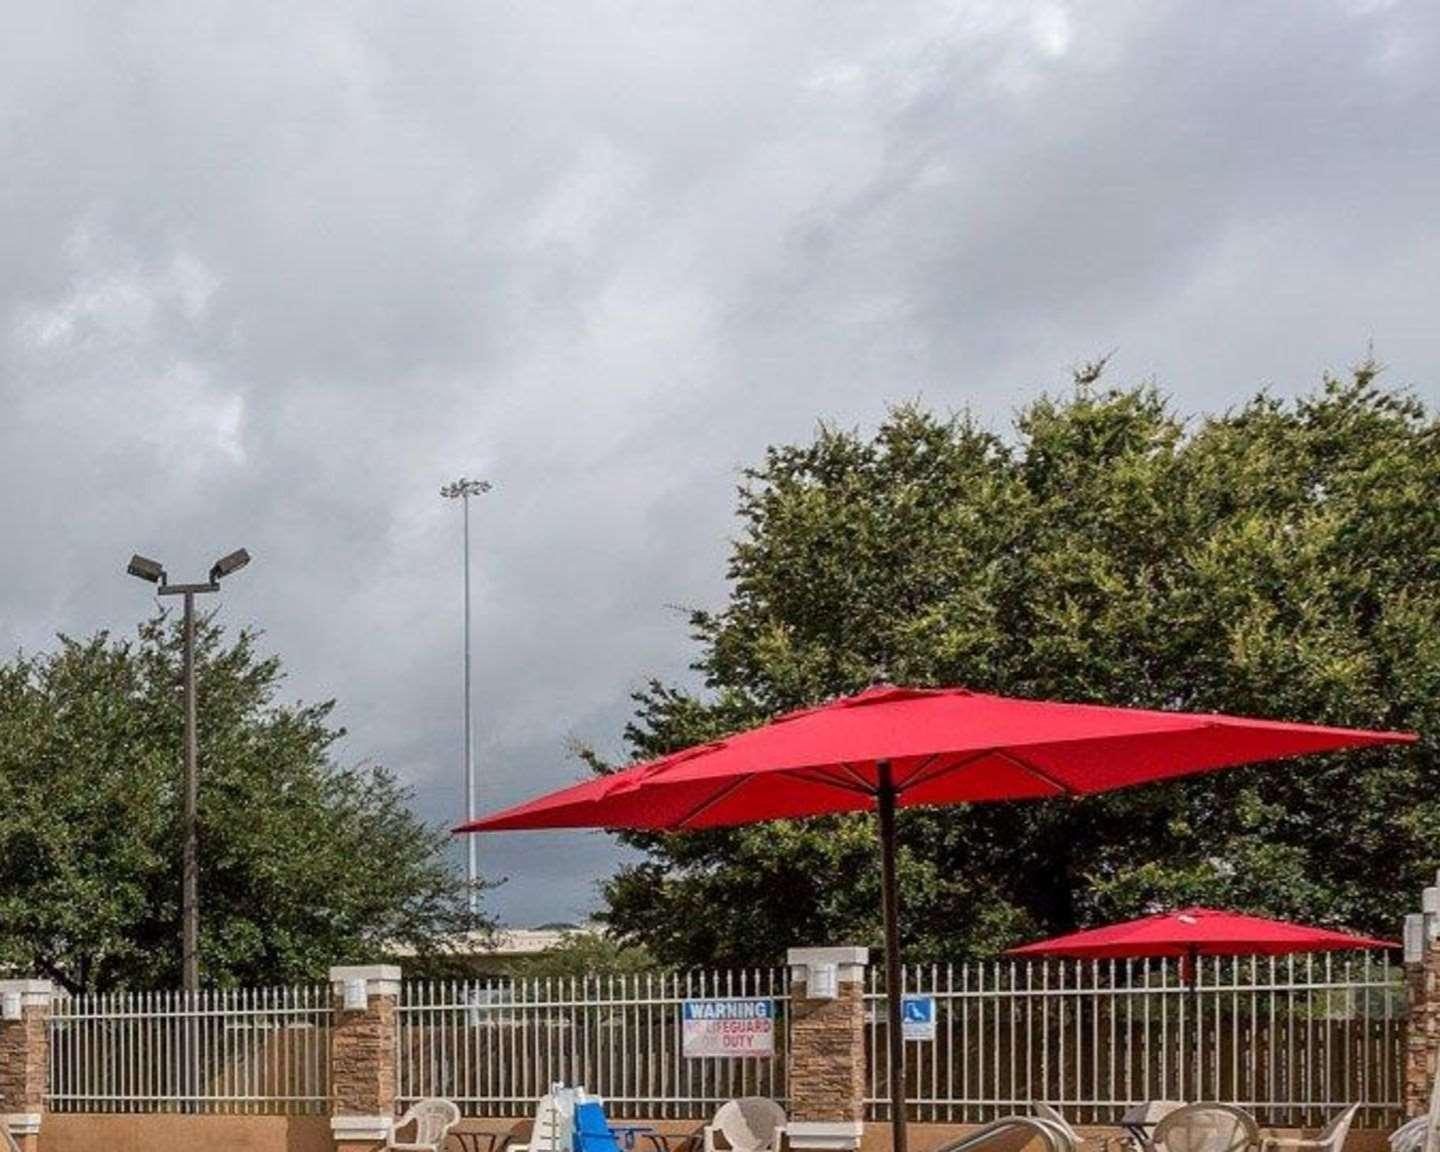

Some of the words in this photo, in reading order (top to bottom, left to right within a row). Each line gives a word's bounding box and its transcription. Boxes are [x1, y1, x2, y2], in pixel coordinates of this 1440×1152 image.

[690, 1002, 767, 1018] WARNING
[706, 1020, 771, 1033] LIFEGUARD
[723, 1035, 754, 1048] DUTY
